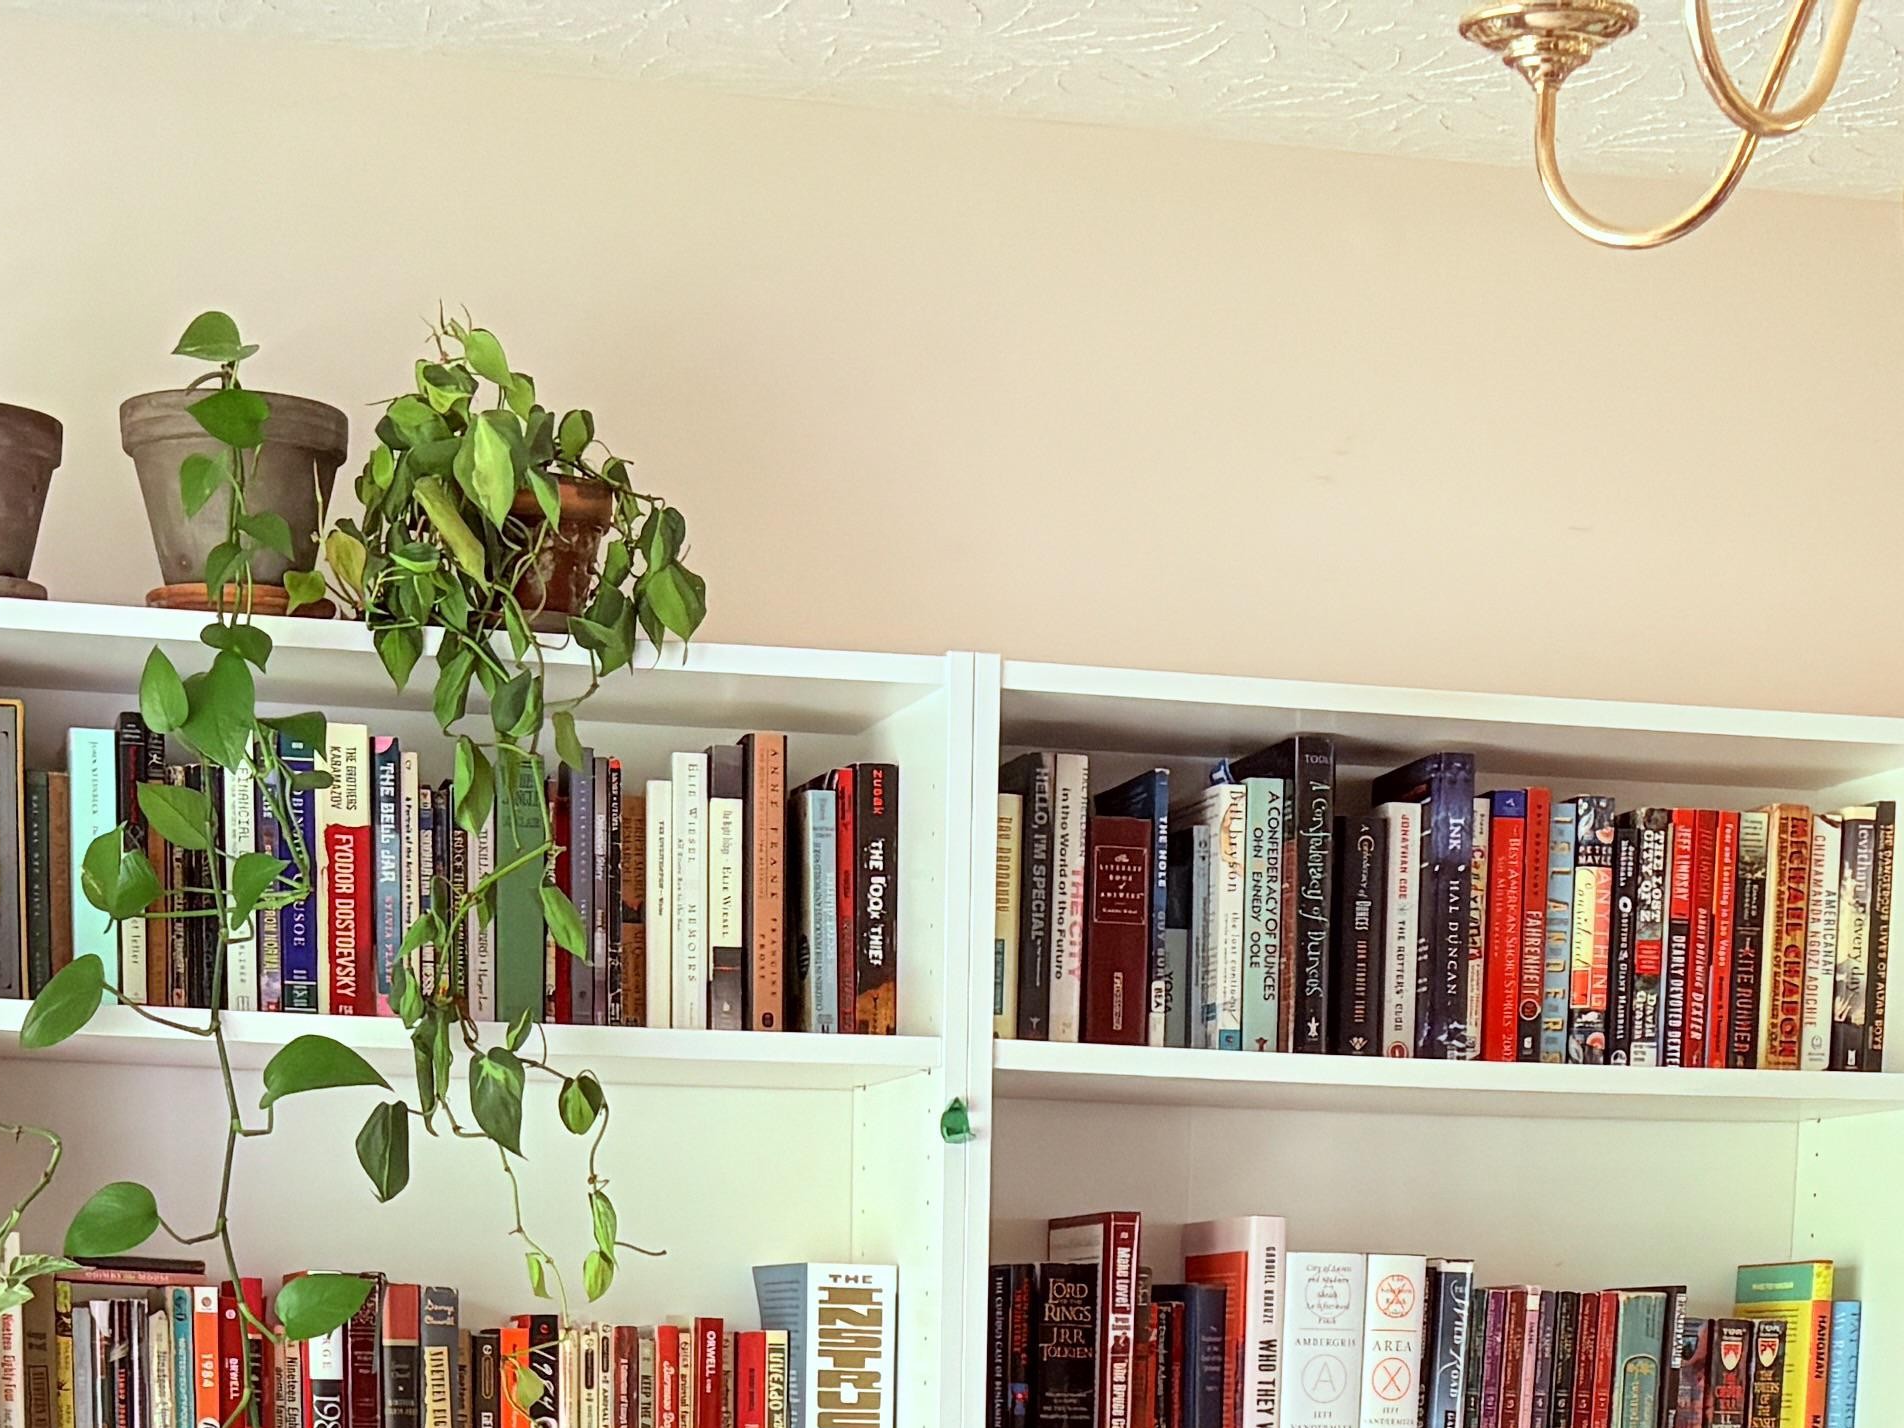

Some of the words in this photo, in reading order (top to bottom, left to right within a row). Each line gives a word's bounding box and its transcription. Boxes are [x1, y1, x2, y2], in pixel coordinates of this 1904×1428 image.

[380, 761, 394, 800] THE
[382, 803, 396, 842] BELL
[332, 834, 354, 895] FYODOR
[333, 899, 356, 997] DOSTOEVSKY
[1821, 890, 1835, 976] AMERICANAH
[1263, 939, 1276, 1001] DUNCES
[1522, 910, 1544, 999] FAHRENHEIT
[828, 1273, 873, 1285] THE
[1259, 1339, 1277, 1372] WHO
[1372, 1340, 1412, 1352] AREA
[1814, 1315, 1828, 1380] HANGMAN
[199, 1353, 215, 1389] 1984
[1258, 1376, 1275, 1417] THEY
